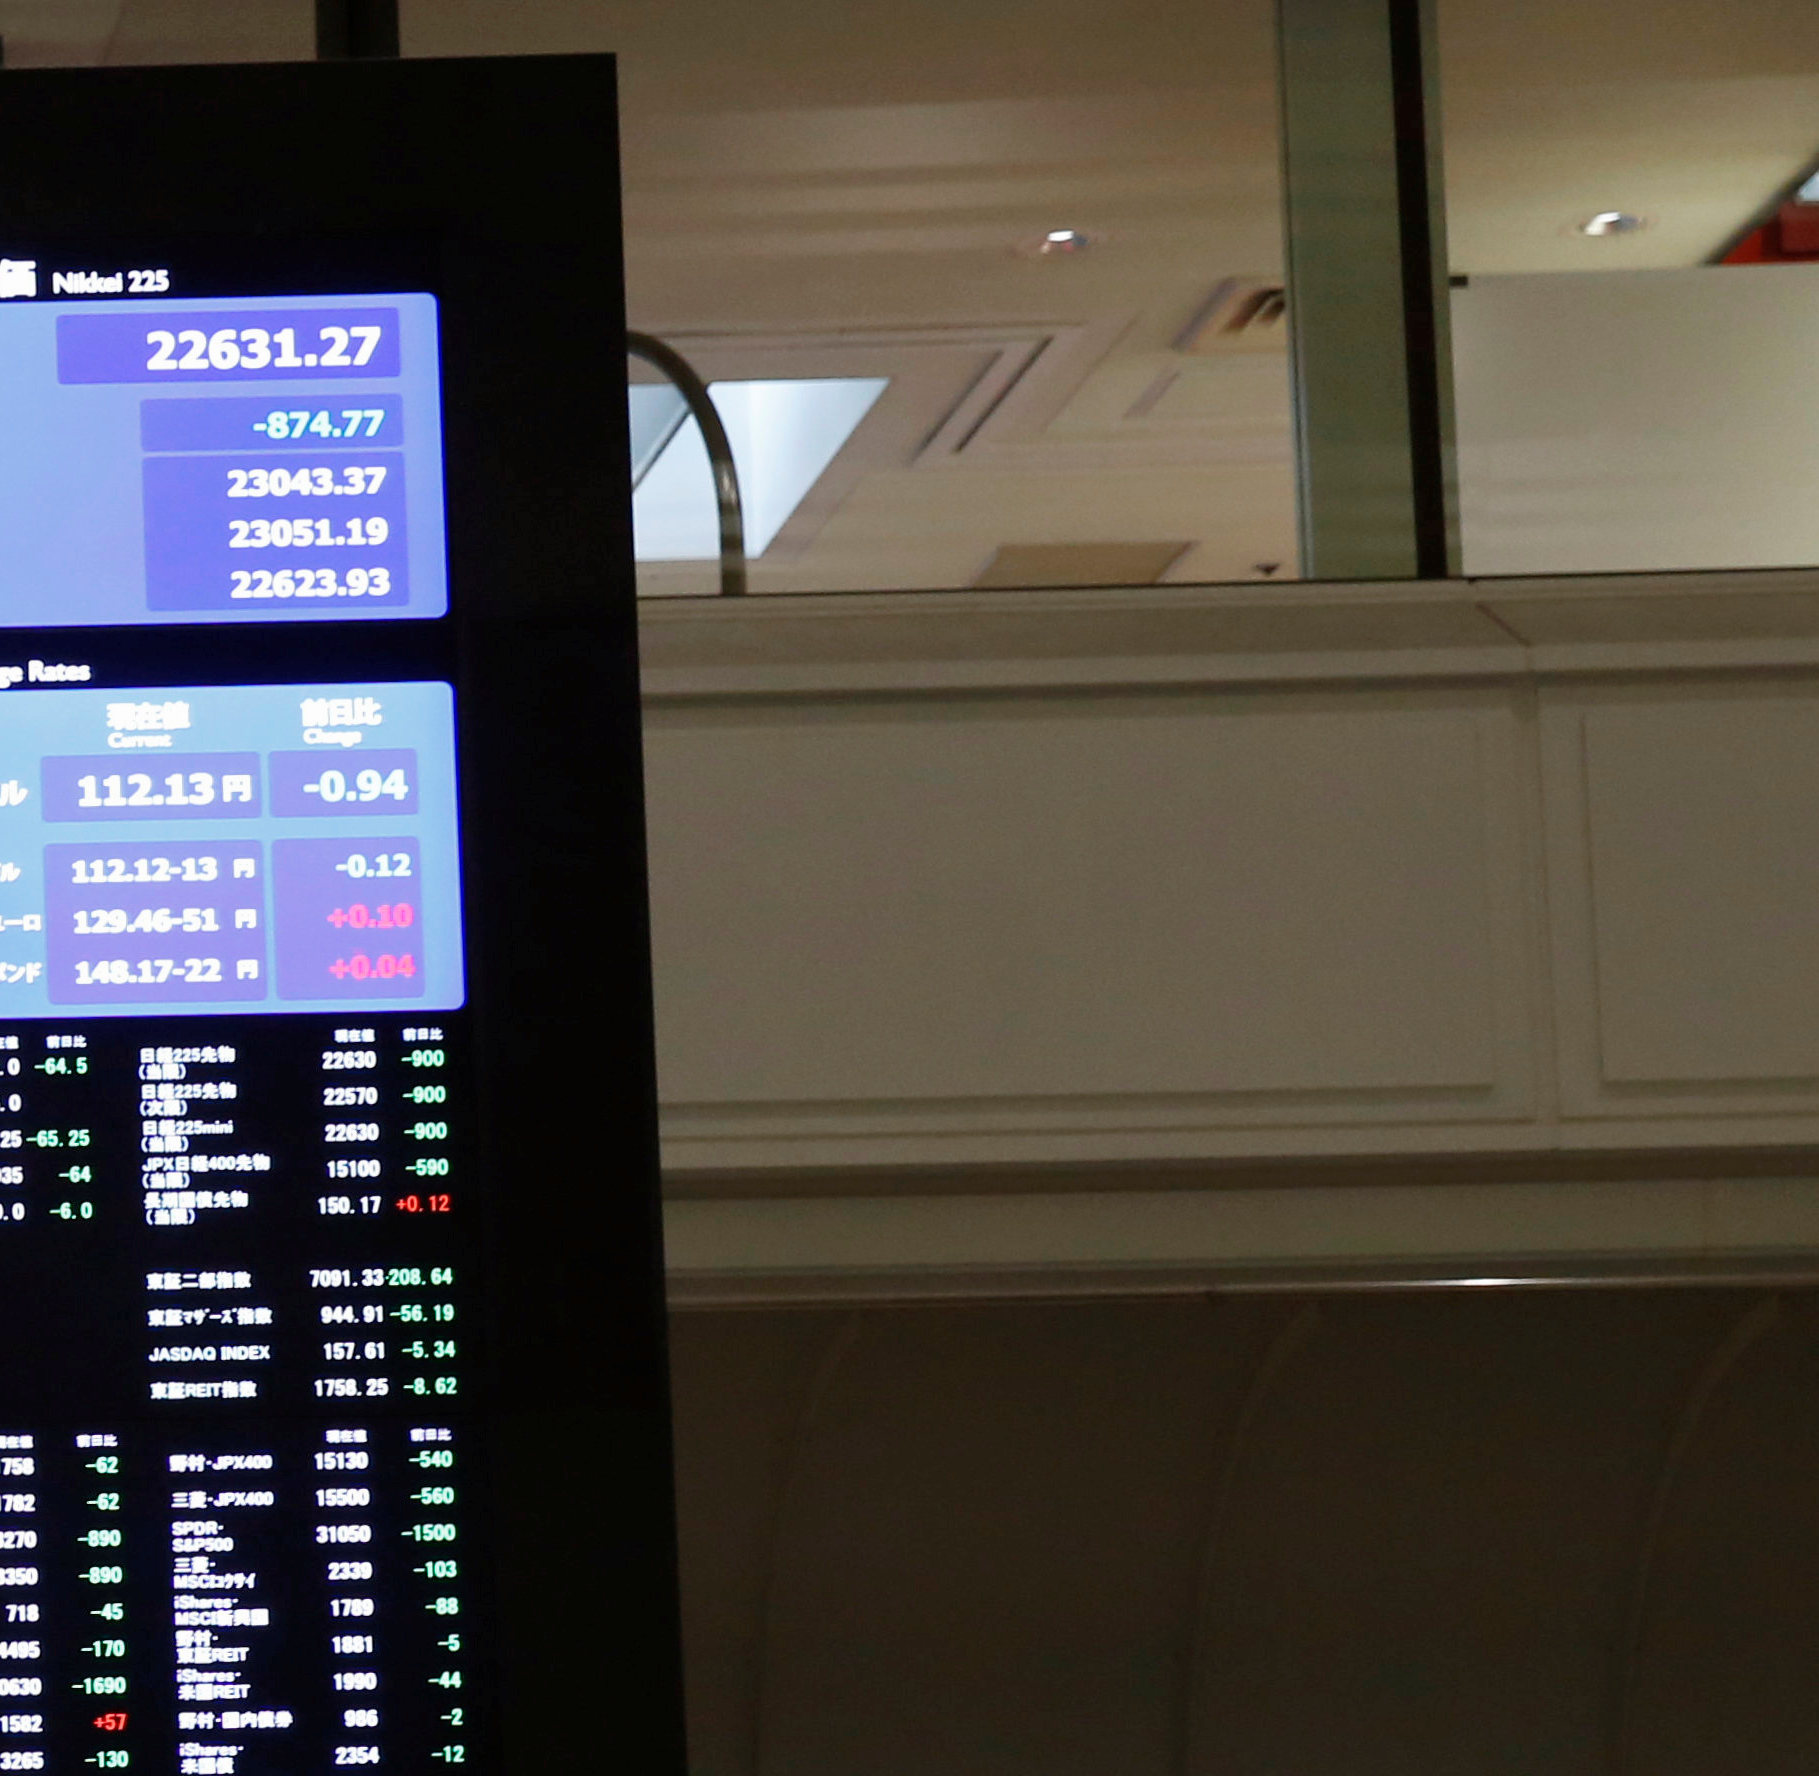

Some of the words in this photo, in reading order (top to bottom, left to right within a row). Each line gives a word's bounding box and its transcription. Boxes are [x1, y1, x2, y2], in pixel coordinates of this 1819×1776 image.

[53, 271, 123, 293] Nikkei
[128, 270, 169, 292] 225
[147, 327, 380, 370] 22631.27
[253, 410, 384, 438] -874.77
[228, 467, 386, 497] 23043.37
[229, 517, 388, 547] 23051.19
[231, 568, 390, 598] 22623.93
[29, 660, 90, 681] Rates
[78, 773, 214, 806] 112.13
[223, 775, 251, 802] 円
[304, 769, 408, 802] -0.94
[72, 857, 217, 883] 112.12-13
[234, 859, 254, 878] 円
[336, 853, 411, 878] -0.12
[74, 909, 219, 933] 129.46-51
[236, 909, 256, 928] 円
[329, 904, 413, 928] +0.10
[76, 959, 221, 984] 148.17-22
[237, 960, 258, 979] 円
[330, 956, 416, 979] +0.04
[148, 1347, 216, 1361] JASDAQ
[221, 1345, 270, 1360] INDEX
[324, 1342, 384, 1360] 157.61
[402, 1341, 455, 1358] -5.34
[314, 1452, 368, 1470] 15130
[409, 1451, 452, 1467] -540
